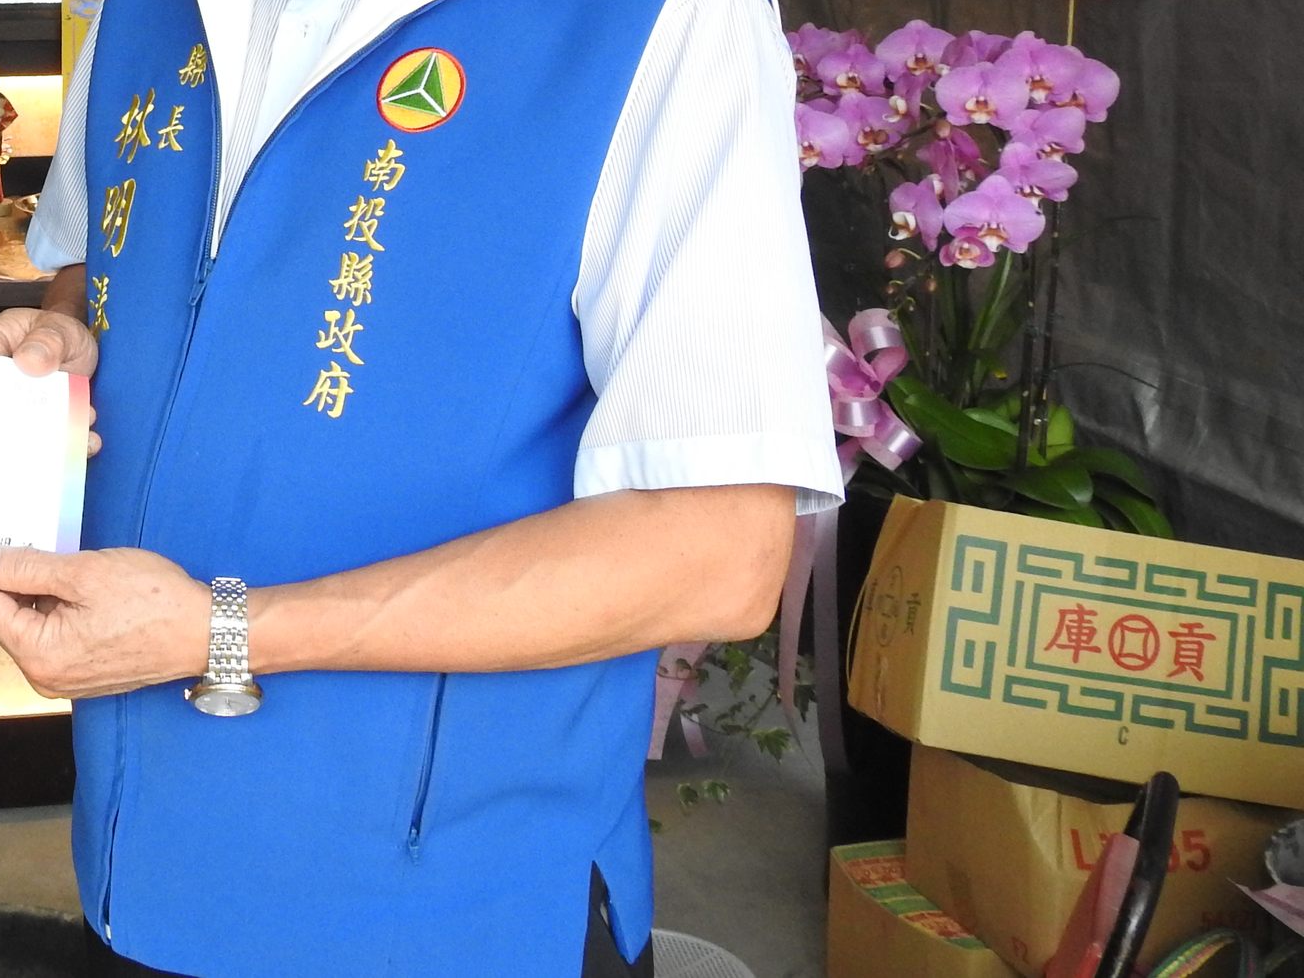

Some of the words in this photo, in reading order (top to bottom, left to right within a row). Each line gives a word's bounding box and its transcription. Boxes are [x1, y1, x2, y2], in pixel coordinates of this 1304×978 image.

[157, 43, 209, 152] 縣長
[302, 138, 406, 419] 南投縣政府
[1043, 603, 1102, 665] 庫
[1166, 621, 1217, 682] 貢
